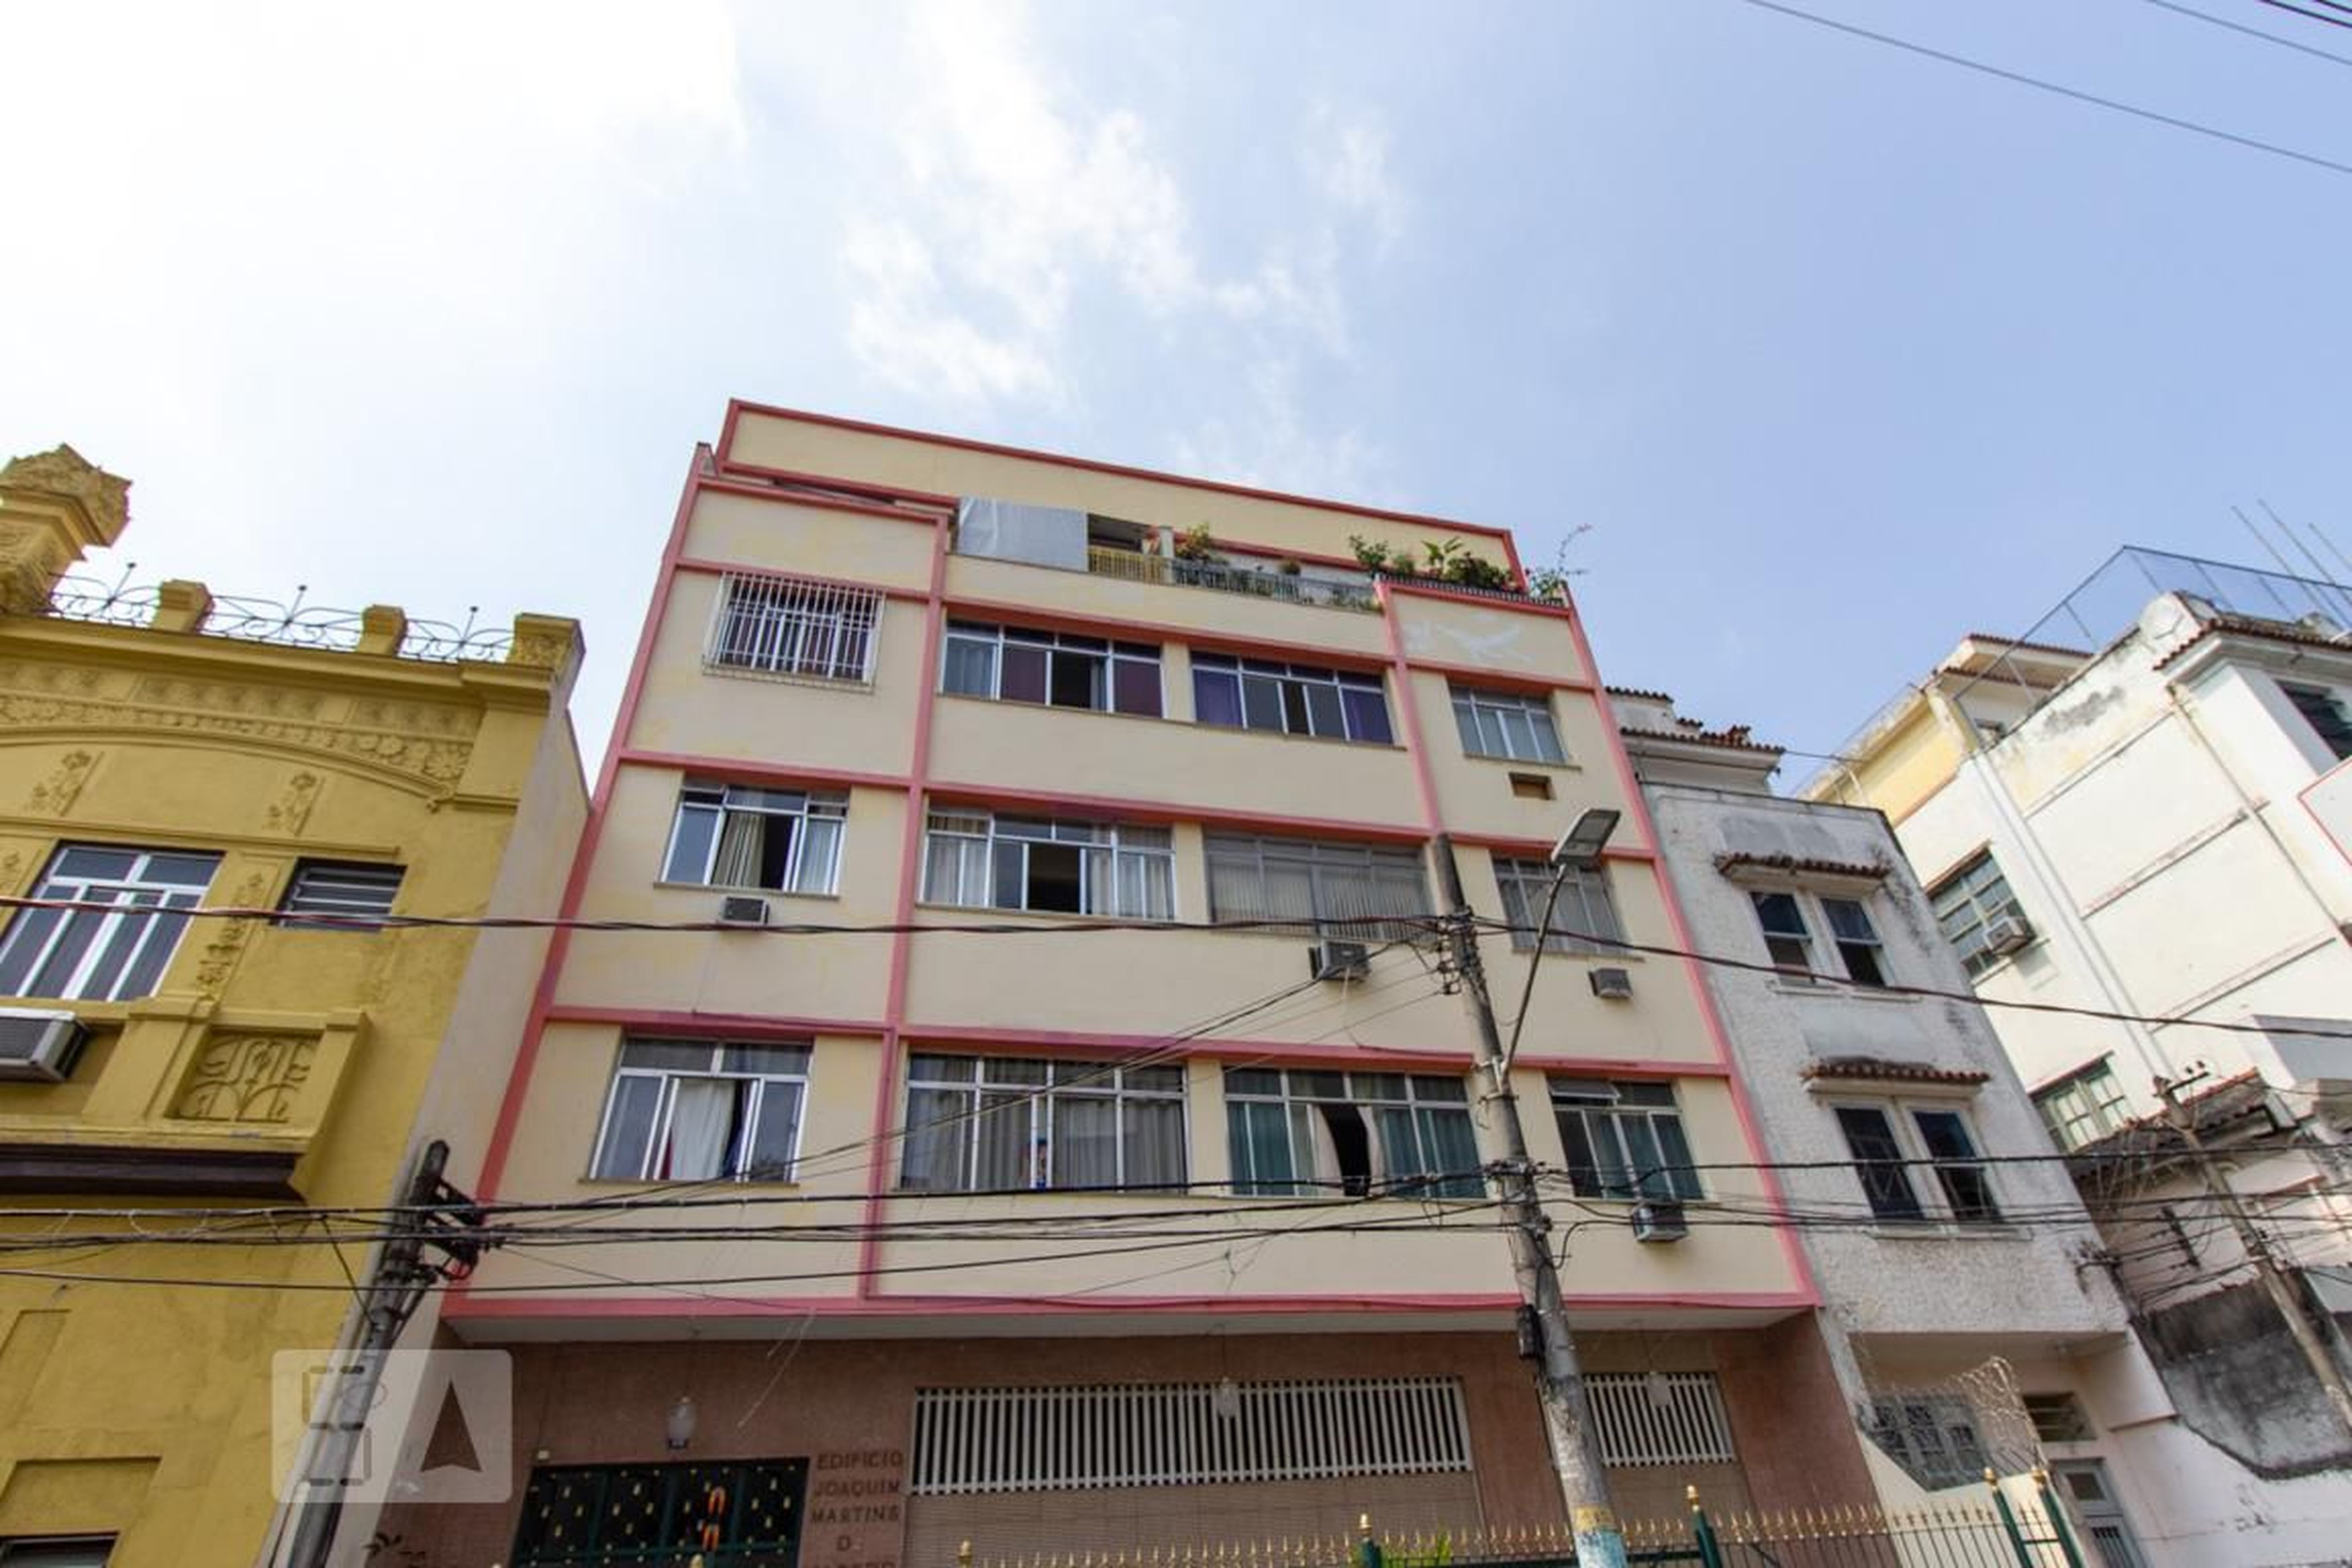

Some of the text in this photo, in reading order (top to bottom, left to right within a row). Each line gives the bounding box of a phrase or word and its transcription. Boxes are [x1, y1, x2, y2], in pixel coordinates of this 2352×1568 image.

[817, 1450, 903, 1469] EDIFICIO
[814, 1479, 900, 1498] JOAQUIM
[812, 1506, 899, 1523] MARTINS
